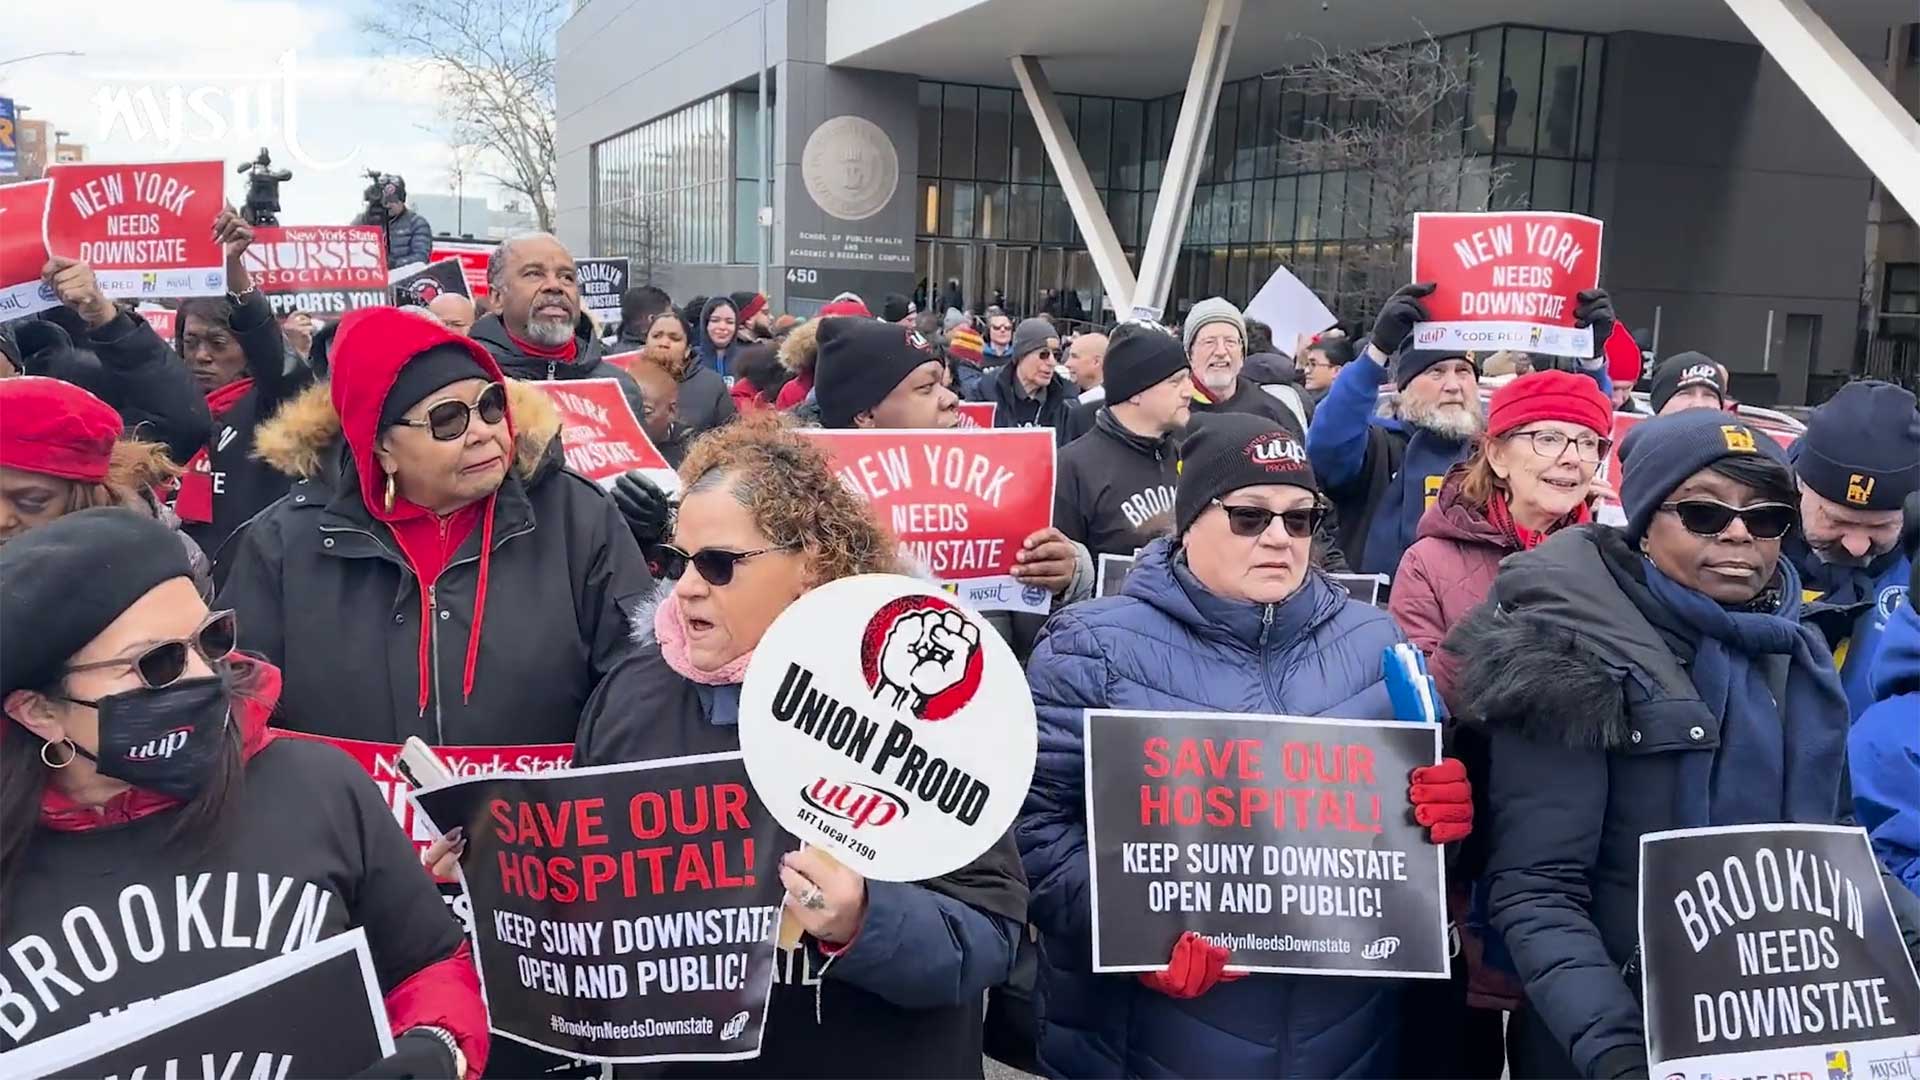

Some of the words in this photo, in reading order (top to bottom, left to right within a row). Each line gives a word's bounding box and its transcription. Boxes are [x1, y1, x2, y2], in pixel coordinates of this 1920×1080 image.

[69, 173, 124, 219] NEW
[133, 171, 196, 217] YORK
[107, 214, 160, 236] NEEDS
[286, 231, 317, 242] New
[317, 229, 347, 242] York
[349, 229, 378, 242] State
[845, 235, 873, 244] PUBLIC
[875, 237, 903, 245] HEALTH
[79, 238, 188, 264] DOWNSTATE
[243, 240, 381, 272] NURSES
[789, 248, 827, 258] ACADEMIC
[837, 251, 874, 260] RESEARCH
[878, 253, 911, 262] COMPLEX
[844, 243, 858, 251] AND
[1452, 222, 1513, 270] NEW
[1525, 221, 1584, 274] YORK
[576, 263, 623, 287] ROOKLYN
[786, 268, 817, 283] 450
[1492, 265, 1554, 288] NEEDS
[267, 291, 346, 314] PPORTS
[348, 291, 386, 310] YOU
[1460, 291, 1567, 320] DOWNSTATE
[1462, 331, 1494, 342] CODE
[554, 390, 612, 430] YORK
[1254, 439, 1307, 464] uup
[836, 446, 912, 500] NEW
[922, 443, 1016, 508] YORK
[891, 502, 969, 533] NEEDS
[128, 729, 189, 759] uup
[1143, 736, 1265, 781] SAVE
[1282, 742, 1377, 785] OUR
[489, 798, 609, 850] SAVE
[628, 783, 752, 841] OUR
[1140, 784, 1384, 834] HOSPITAL!
[797, 807, 818, 825] AFT
[817, 819, 848, 844] Local
[848, 838, 877, 861] 2190
[498, 837, 757, 903] HOSPITAL!
[1122, 842, 1180, 874] KEEP
[1186, 843, 1255, 876] SUNY
[1262, 847, 1408, 882] DOWNSTATE
[1148, 881, 1212, 913] OPEN
[1219, 882, 1272, 915] AND
[1281, 885, 1383, 918] PUBLIC!
[1673, 847, 1865, 953] BROOKLYN
[493, 909, 537, 950] KEEP
[539, 917, 604, 956] SUNY
[613, 904, 773, 954] DOWNSTATE
[0, 871, 333, 1043] BROOKLYN
[1735, 926, 1840, 977] NEEDS
[517, 954, 569, 996] OPEN
[573, 960, 628, 1000] AND
[636, 952, 748, 995] PUBLIC!
[1693, 977, 1897, 1043] DOWNSTATE
[549, 1014, 713, 1042] #BrooklynNeedsDownstate
